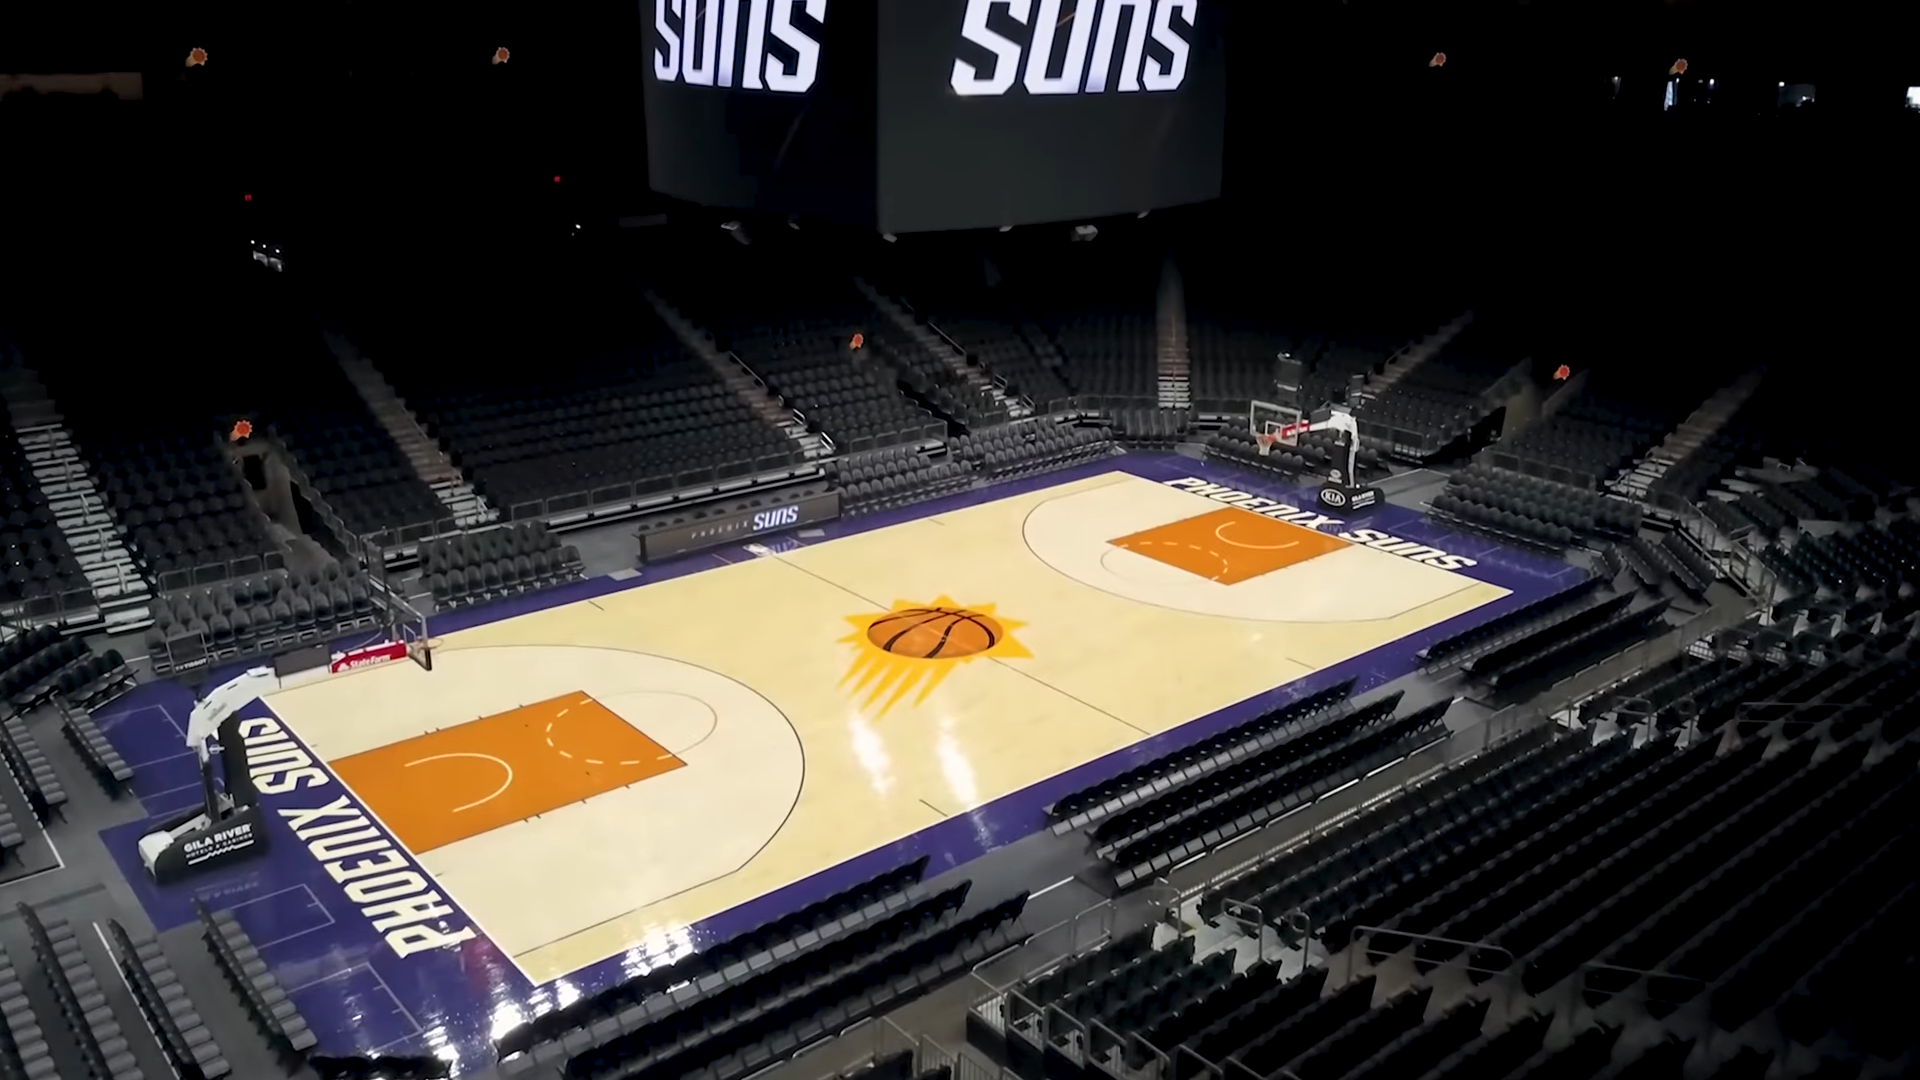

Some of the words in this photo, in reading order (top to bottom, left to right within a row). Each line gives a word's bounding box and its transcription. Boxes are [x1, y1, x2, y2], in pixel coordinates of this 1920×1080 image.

[654, 0, 827, 93] SUNS
[950, 0, 1197, 95] SUNS
[752, 505, 798, 531] SUNS
[1162, 476, 1345, 529] PHOENIX
[1338, 529, 1477, 570] SUNS
[184, 837, 213, 852] GILA
[214, 823, 251, 842] RIVER
[277, 794, 477, 958] PHOENIX
